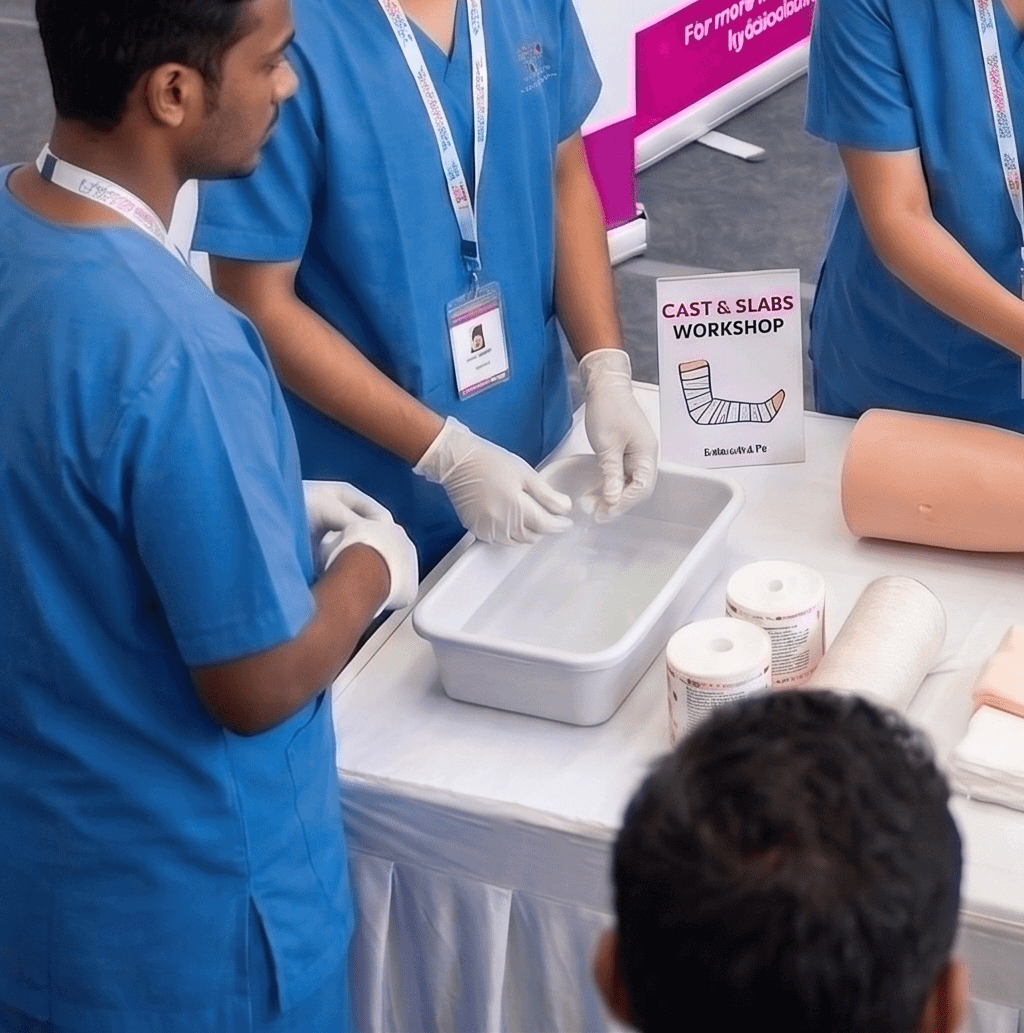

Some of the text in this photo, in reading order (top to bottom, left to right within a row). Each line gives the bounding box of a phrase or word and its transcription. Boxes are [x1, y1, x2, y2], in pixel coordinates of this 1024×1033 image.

[684, 18, 712, 45] For
[662, 295, 794, 319] CAST & SLABS
[673, 318, 784, 340] WORKSHOP
